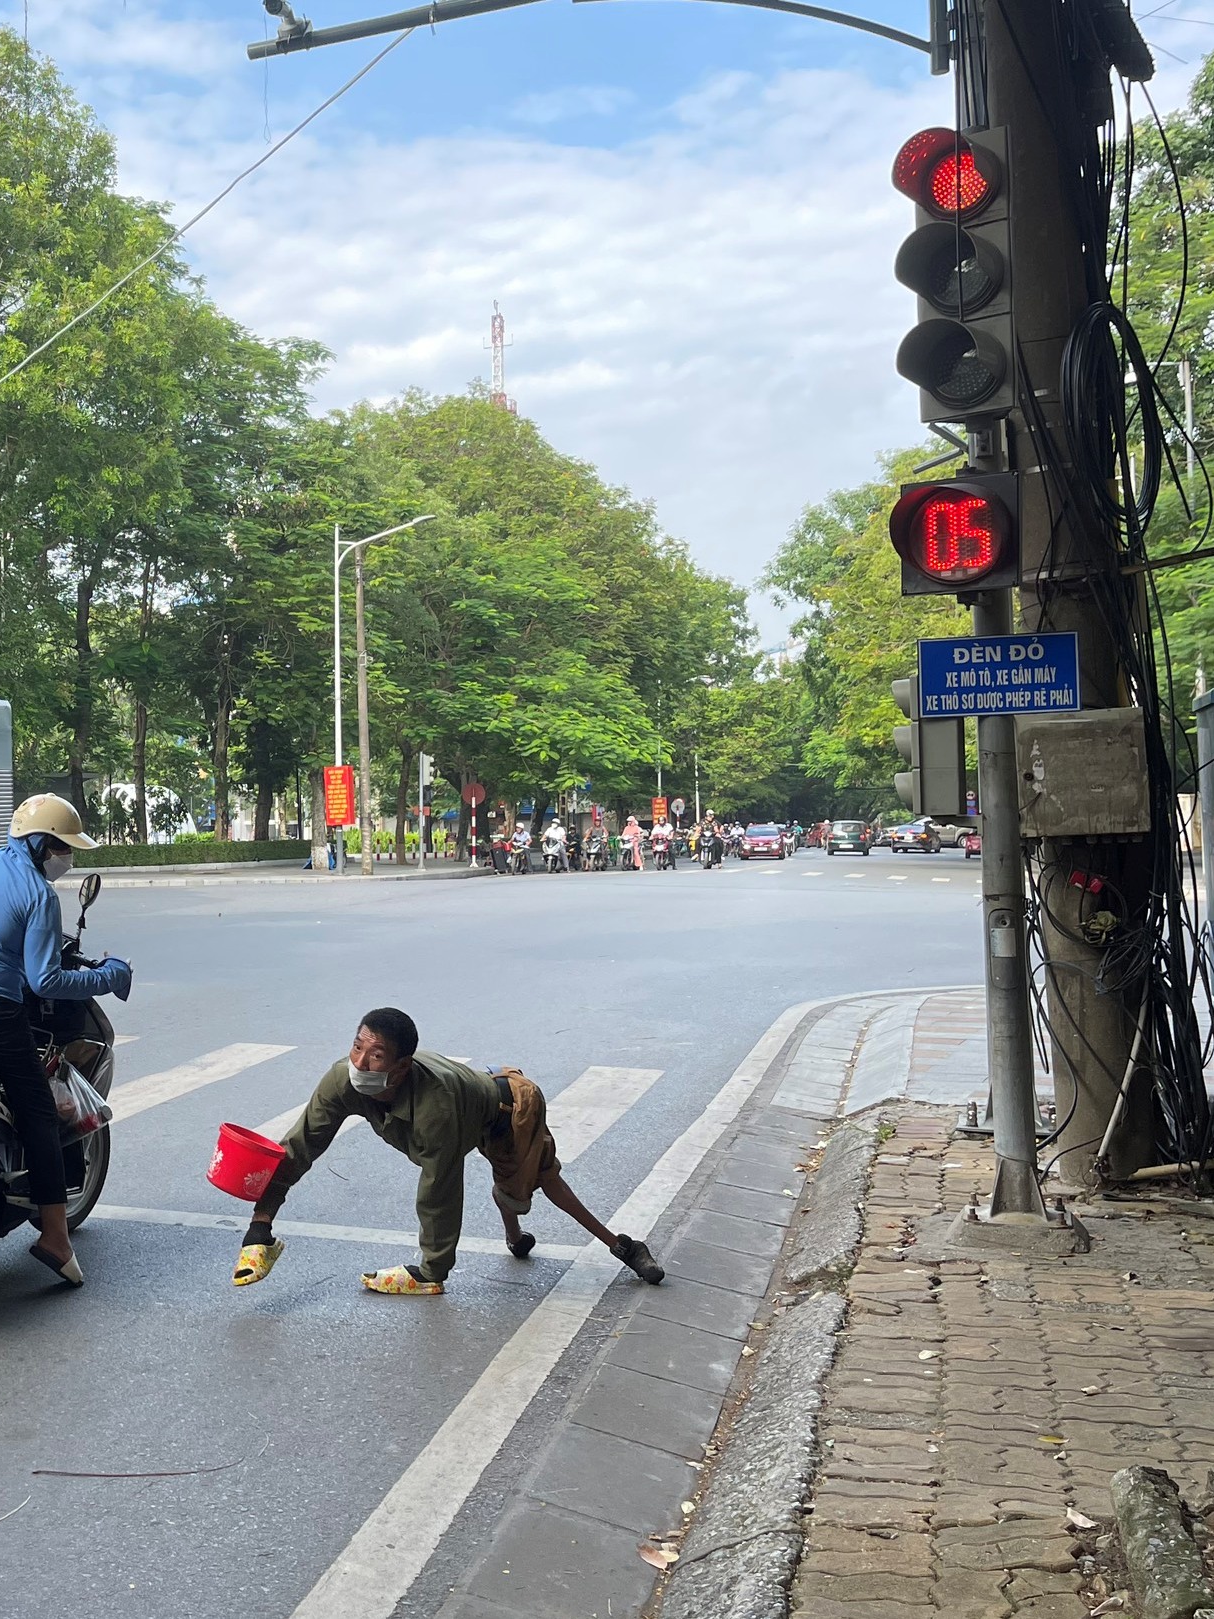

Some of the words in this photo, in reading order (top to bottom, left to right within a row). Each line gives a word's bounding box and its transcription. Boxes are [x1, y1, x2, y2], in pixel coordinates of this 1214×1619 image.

[925, 498, 993, 571] 05
[953, 643, 1002, 664] ĐÈN
[1008, 637, 1044, 661] ĐỎ
[946, 671, 959, 688] XE
[960, 668, 976, 687] MÔ
[978, 668, 995, 688] TÔ,
[996, 669, 1008, 686] XE
[1034, 664, 1057, 684] MÁY
[926, 695, 939, 711] XE
[940, 692, 959, 710] THÔ
[961, 692, 975, 710] SƠ
[977, 691, 1004, 712] ĐƯỢC
[1005, 688, 1031, 708] PHÉP
[1034, 687, 1047, 707] RẼ
[1049, 683, 1074, 706] PHẢI
